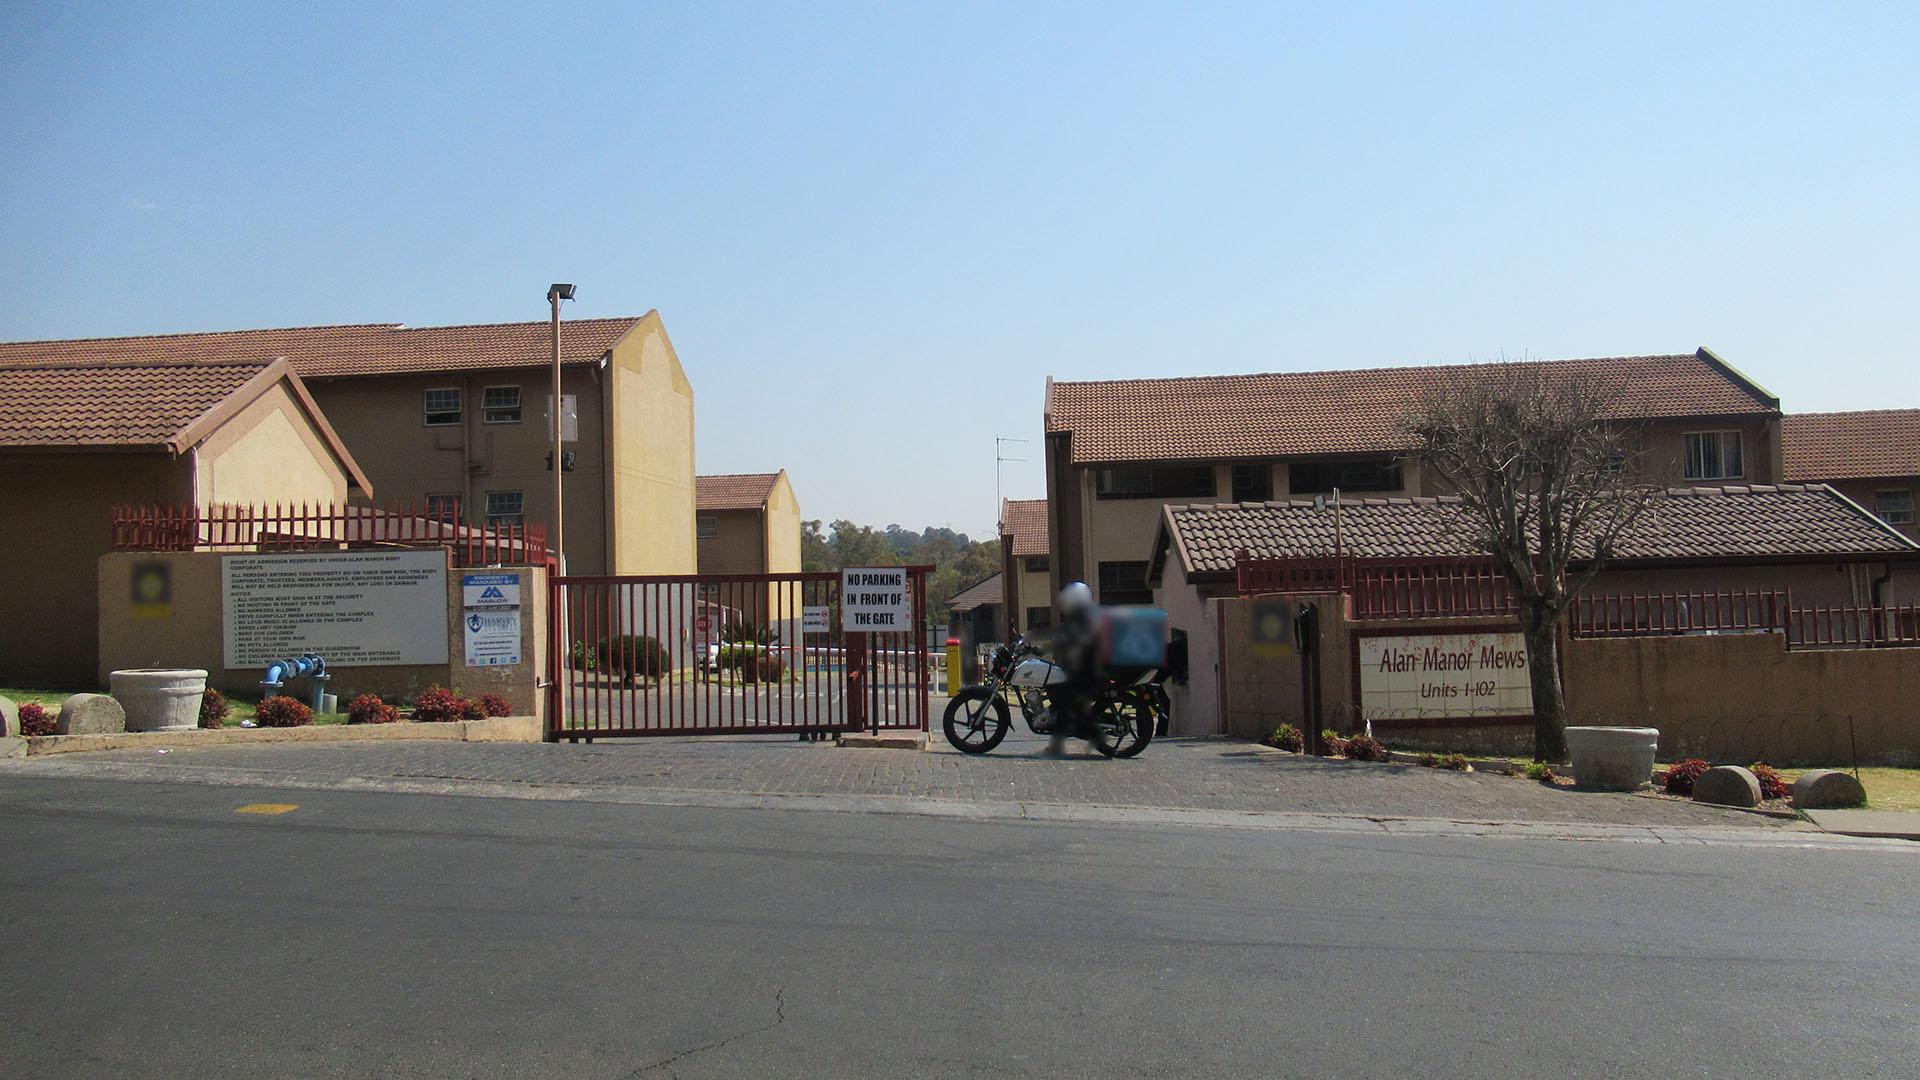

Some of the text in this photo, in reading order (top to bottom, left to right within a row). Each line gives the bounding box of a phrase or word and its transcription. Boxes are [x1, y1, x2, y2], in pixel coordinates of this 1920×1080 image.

[848, 574, 901, 586] NO PARKING
[847, 593, 901, 605] IN FRONT OF
[855, 612, 894, 624] THE GATE
[1380, 645, 1525, 672] Alan Manor Mews
[1421, 683, 1458, 698] Units
